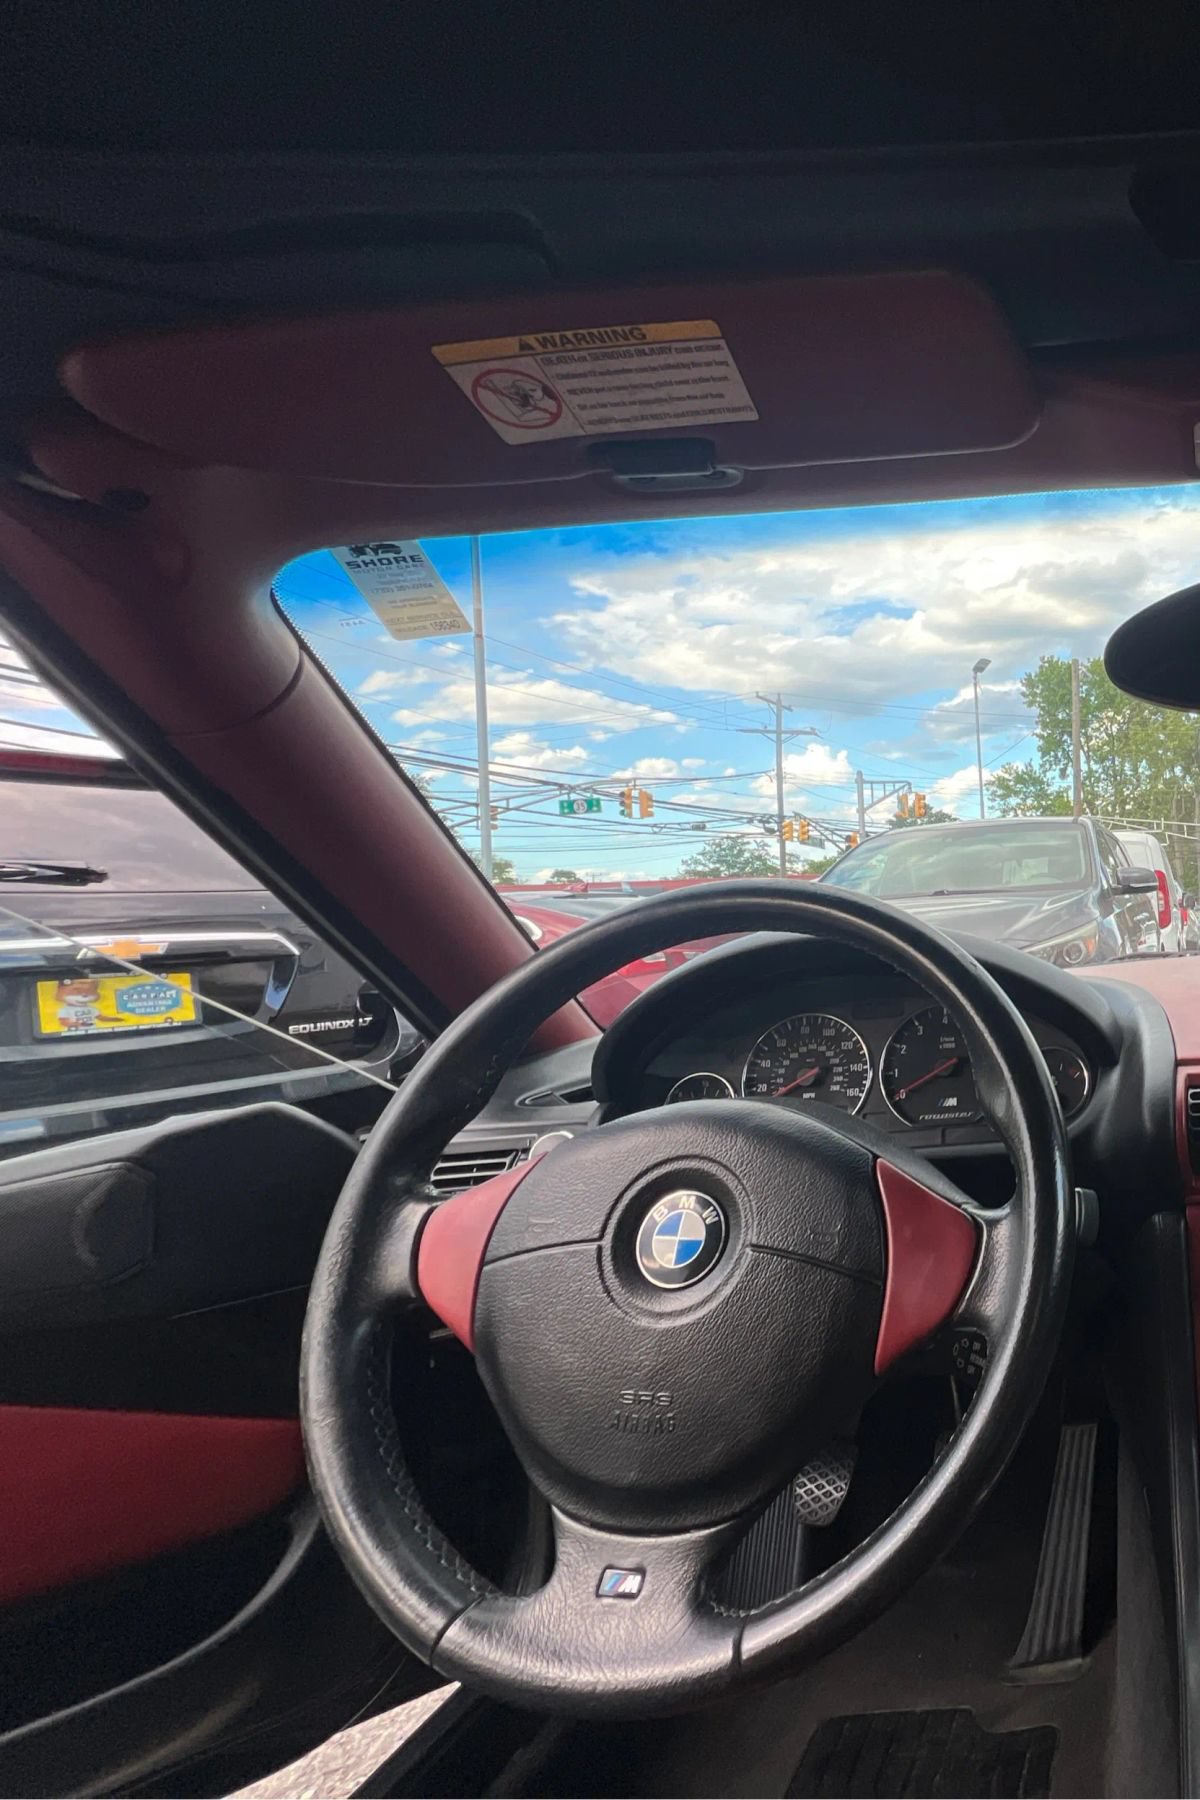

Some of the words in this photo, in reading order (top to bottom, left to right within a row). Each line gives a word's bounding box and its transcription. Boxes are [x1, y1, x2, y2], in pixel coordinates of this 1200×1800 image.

[536, 326, 647, 350] WARNING
[345, 554, 425, 570] SHORE
[288, 1018, 355, 1035] EQUINOX
[358, 1017, 373, 1027] LT
[917, 1025, 923, 1036] 3
[822, 1028, 835, 1037] 100
[841, 1041, 853, 1050] 120
[900, 1045, 907, 1055] 2
[760, 1059, 771, 1068] 40
[849, 1063, 863, 1072] 140
[894, 1068, 899, 1078] 1
[757, 1083, 767, 1092] 20
[846, 1088, 860, 1097] 160
[899, 1089, 906, 1099] 0
[652, 1195, 719, 1225] BMW
[619, 1390, 673, 1406] SRS
[618, 1574, 642, 1594] M
